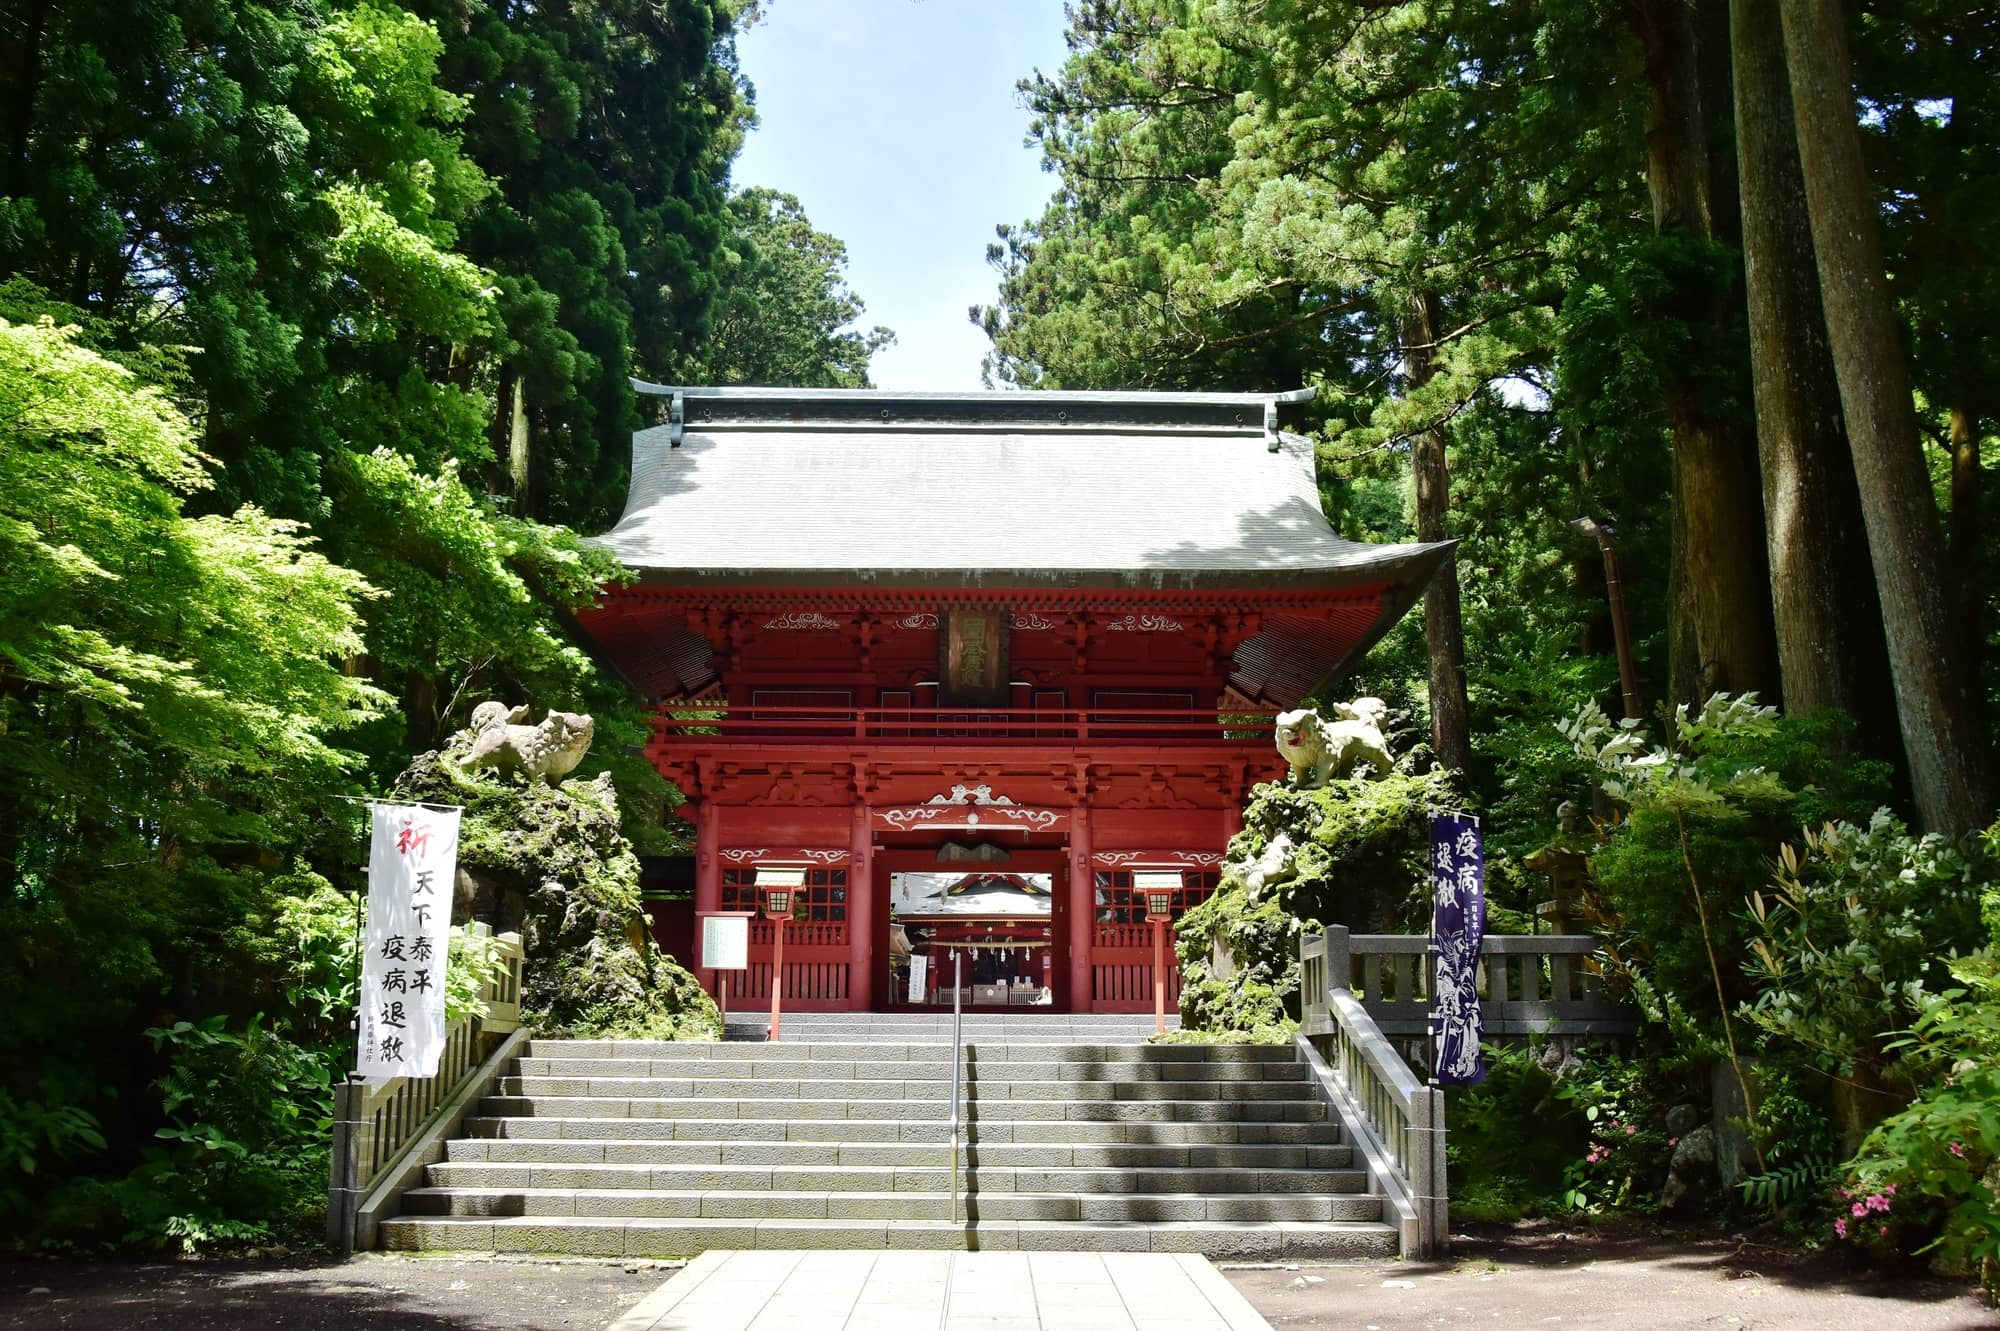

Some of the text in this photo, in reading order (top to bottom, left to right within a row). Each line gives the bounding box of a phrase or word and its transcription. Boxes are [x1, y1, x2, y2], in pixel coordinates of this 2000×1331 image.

[395, 821, 433, 859] 祈
[1455, 827, 1479, 895] 疫病
[1436, 842, 1459, 909] 退散
[409, 870, 435, 996] 天下泰平
[380, 934, 408, 1063] 疫病退散
